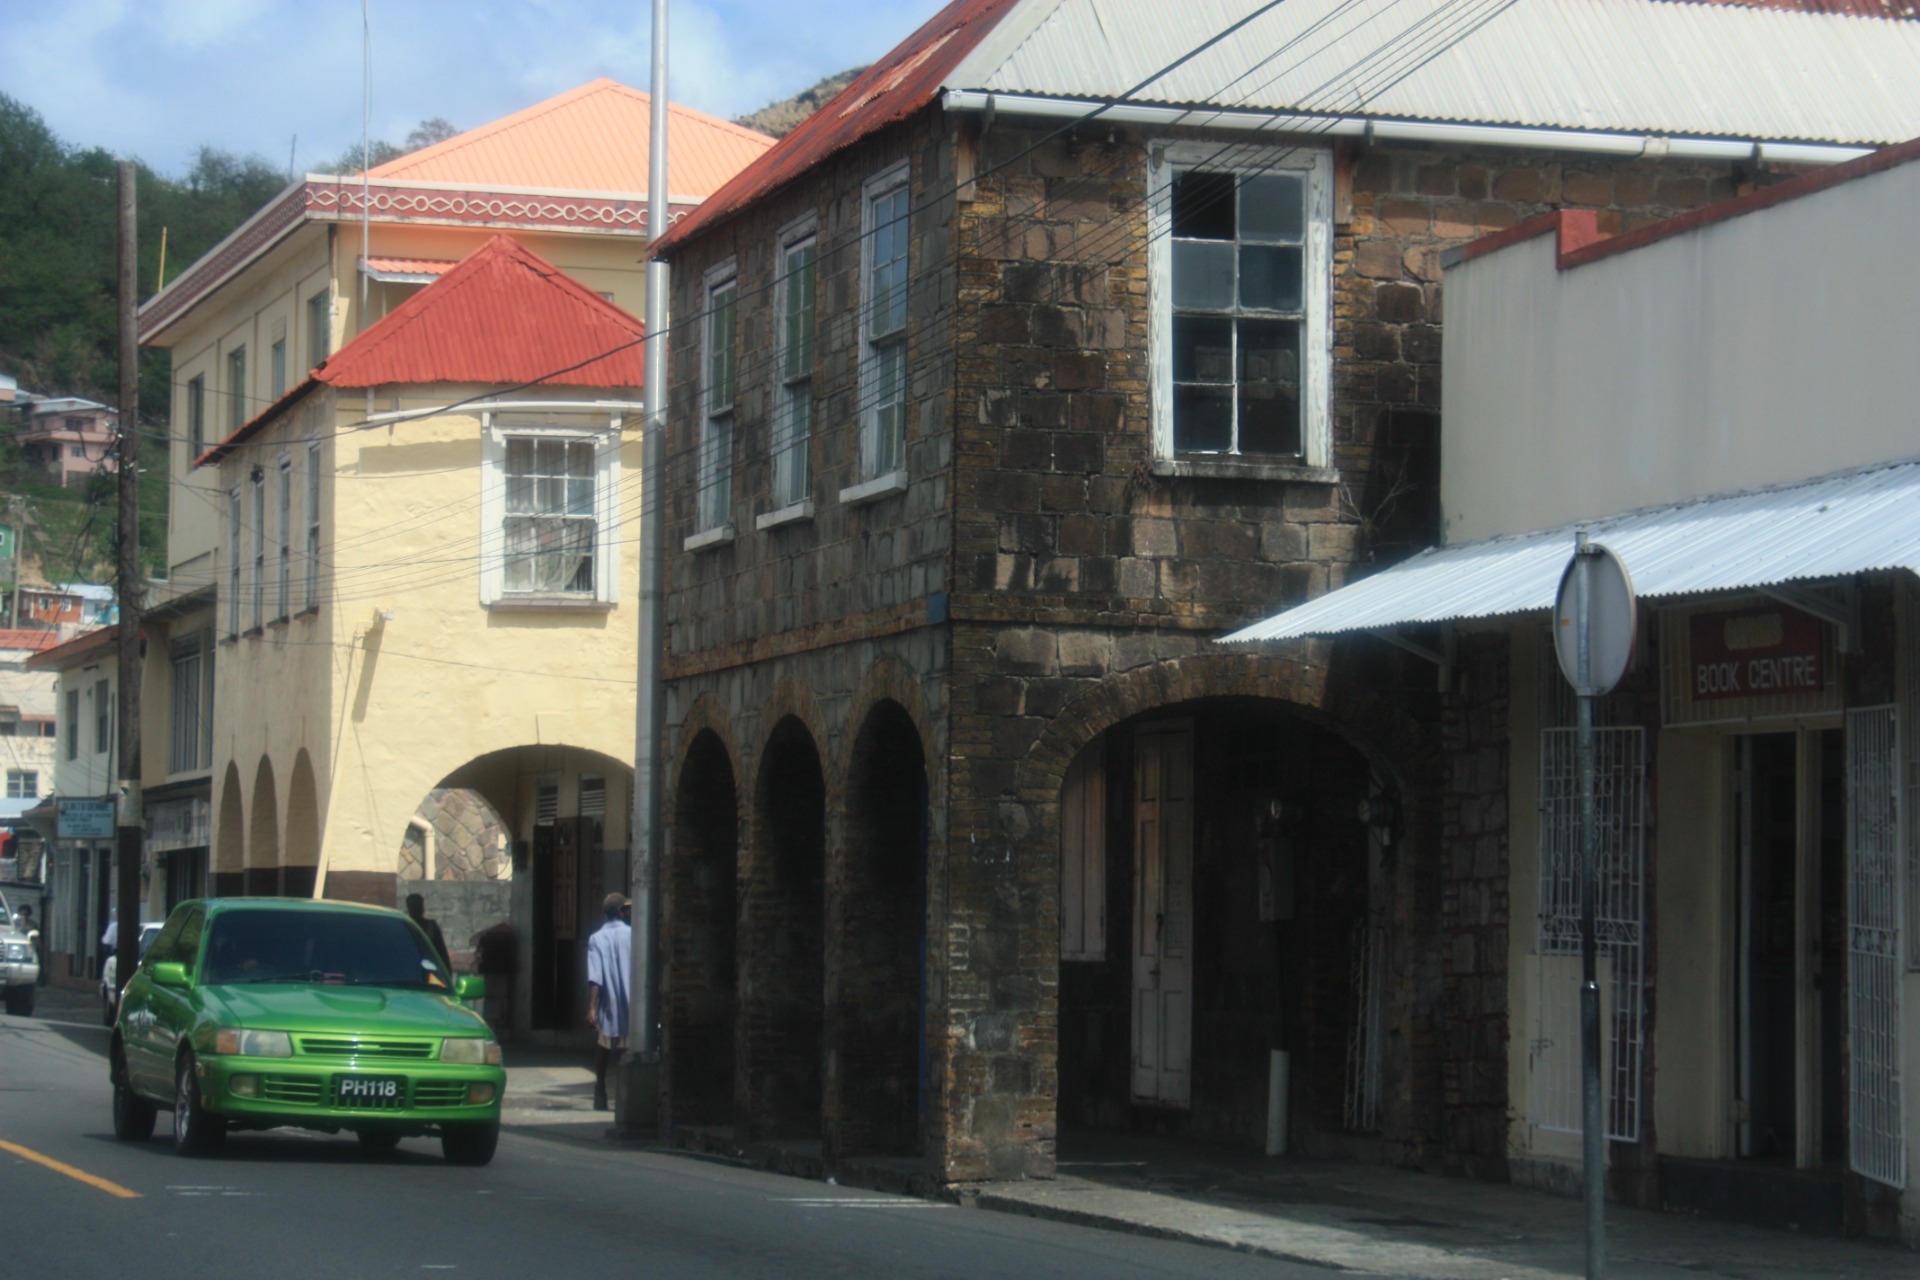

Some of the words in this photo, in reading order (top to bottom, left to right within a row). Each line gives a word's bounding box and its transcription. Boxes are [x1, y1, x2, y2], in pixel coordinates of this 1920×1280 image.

[1697, 661, 1741, 694] BOOK
[1748, 655, 1816, 689] CENTRE
[341, 1079, 397, 1097] PH118
